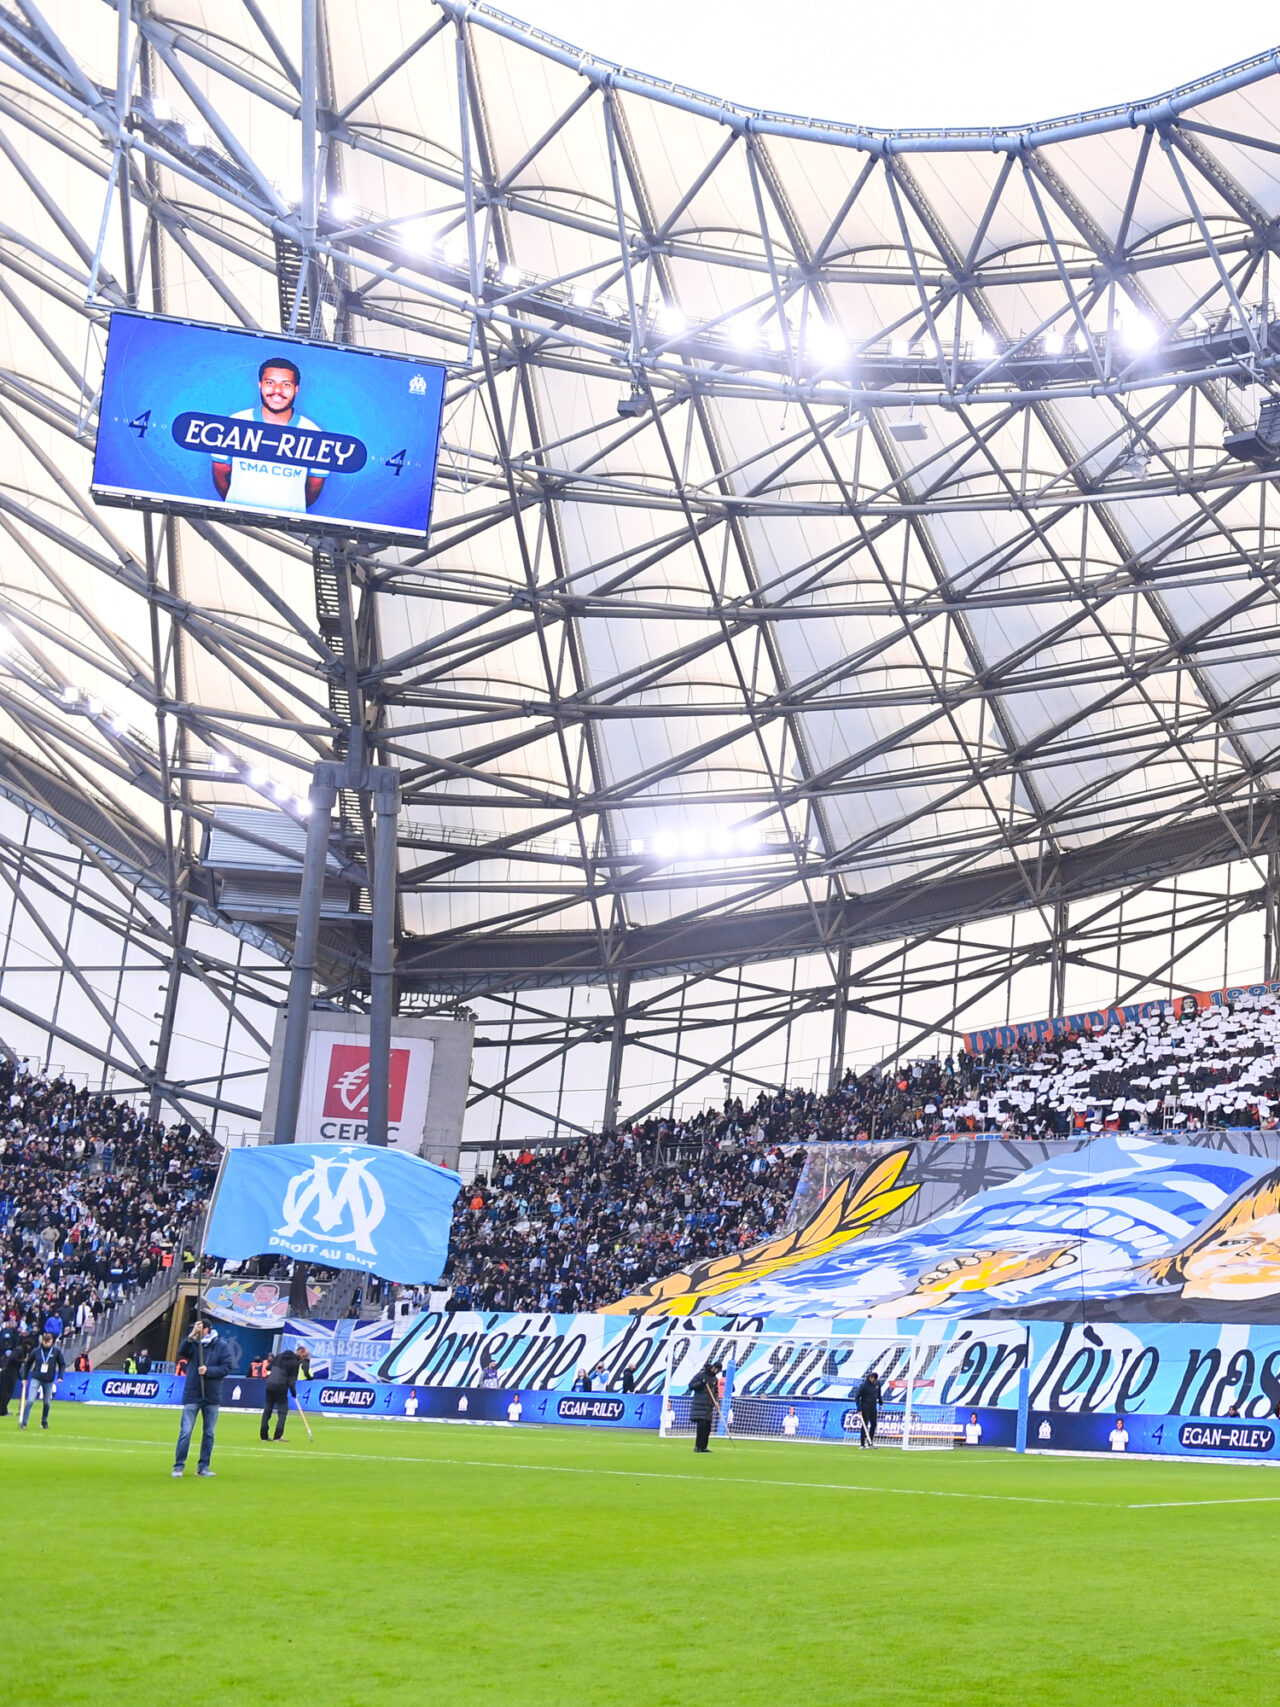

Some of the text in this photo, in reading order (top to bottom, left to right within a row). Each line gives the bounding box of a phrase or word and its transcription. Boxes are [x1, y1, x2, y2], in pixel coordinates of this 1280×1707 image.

[128, 409, 151, 438] 4
[185, 419, 356, 466] EGAN-RILEY
[385, 448, 406, 476] 4
[320, 1122, 400, 1143] CEPC
[269, 1237, 376, 1268] DROIT AU BUT
[314, 1341, 382, 1360] MARSEILLE
[378, 1311, 588, 1390] Christino
[1028, 1322, 1159, 1414] lève
[78, 1379, 90, 1395] 4
[104, 1381, 158, 1396] EGAN-RILEY
[166, 1382, 175, 1398] 4
[303, 1387, 311, 1404] 4
[320, 1390, 374, 1405] EGAN-RILEY
[384, 1391, 393, 1408] 4
[538, 1398, 548, 1416] 4
[559, 1401, 622, 1417] EGAN-RILEY
[635, 1402, 645, 1420] 4
[1152, 1424, 1164, 1445] 4
[1182, 1427, 1272, 1447] EGAN-RILEY
